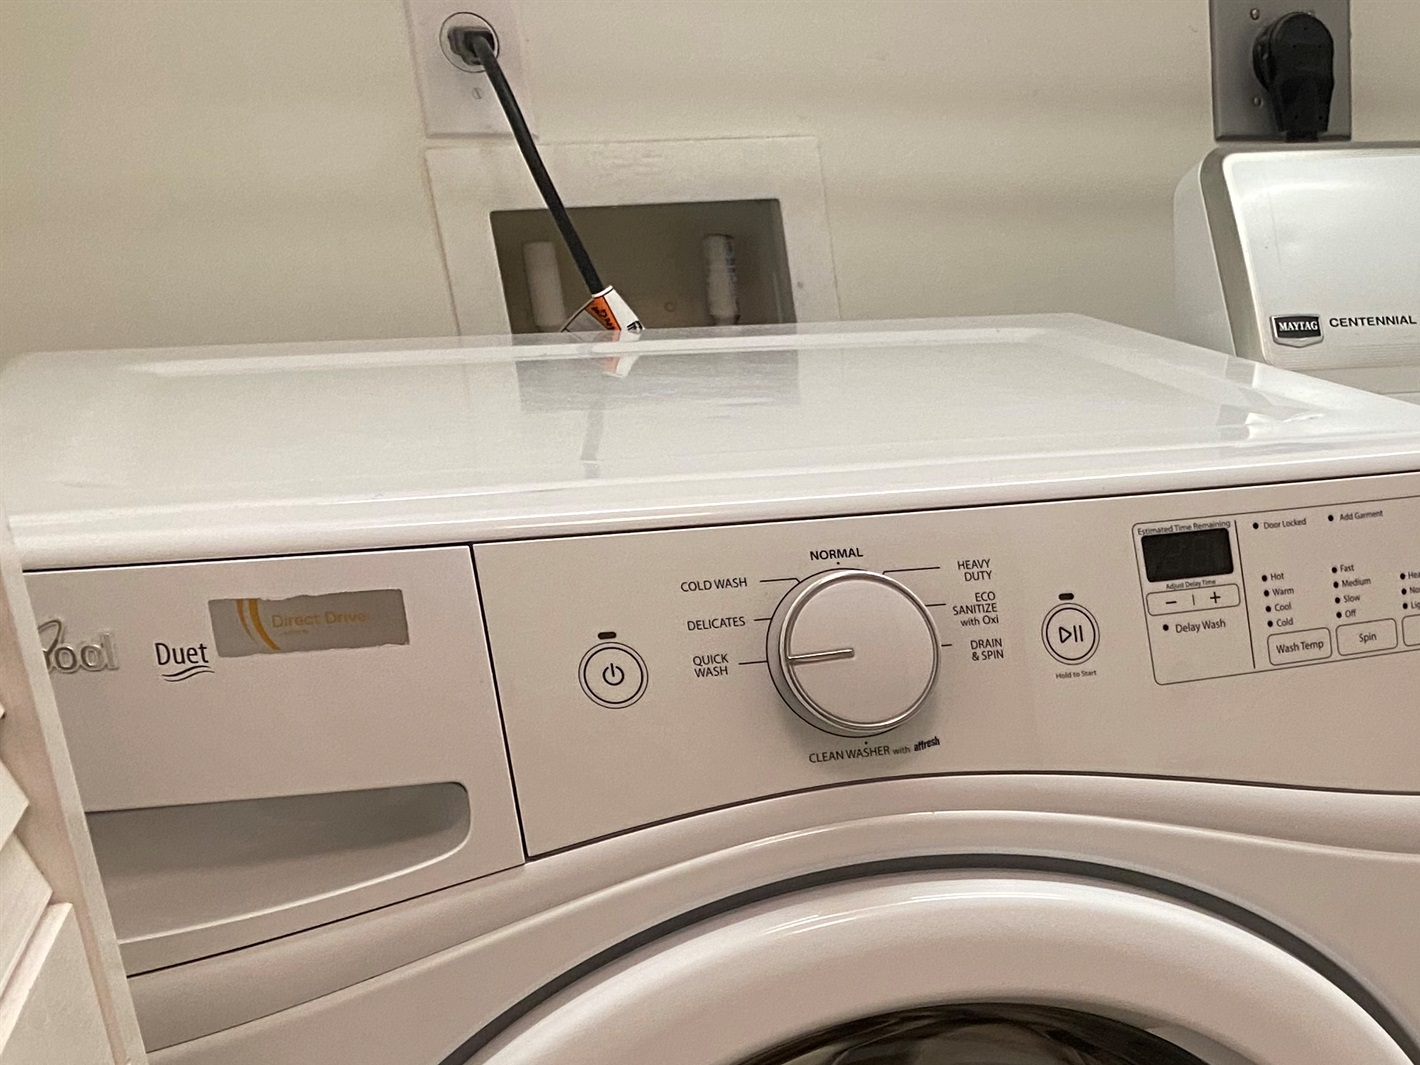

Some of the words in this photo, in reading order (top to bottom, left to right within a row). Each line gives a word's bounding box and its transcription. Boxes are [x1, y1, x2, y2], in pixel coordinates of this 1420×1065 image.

[1278, 321, 1319, 332] MAYTAG
[1329, 315, 1417, 328] CENTENNIAL
[1339, 513, 1353, 521] Add
[1354, 510, 1383, 520] Garment
[1137, 525, 1174, 536] Estimated
[1174, 523, 1192, 532] Time
[1192, 520, 1231, 530] Remaining
[1263, 521, 1281, 530] Door
[1281, 518, 1307, 528] Locked
[809, 547, 864, 561] NORMAL
[957, 558, 991, 570] HEAVY
[1340, 564, 1355, 573] Fast
[964, 570, 992, 582] DUTY
[1270, 572, 1284, 581] Hot
[680, 580, 712, 593] COLD
[713, 577, 748, 590] WASH
[1165, 582, 1184, 590] Adjust
[1184, 580, 1201, 588] Delay
[1341, 578, 1372, 588] Medium
[975, 591, 996, 602] ECO
[1272, 587, 1295, 596] Warm
[1343, 594, 1361, 603] Slow
[952, 603, 998, 616] SANITIZE
[1274, 602, 1292, 612] Cool
[271, 613, 320, 628] Direct
[324, 611, 368, 624] Drive
[1345, 609, 1356, 618] Off
[687, 616, 746, 631] DELICATES
[960, 618, 980, 627] with
[982, 615, 999, 625] Oxi
[1175, 621, 1201, 633] Delay
[1201, 619, 1226, 630] Wash
[1276, 617, 1294, 627] Cold
[1358, 632, 1377, 643] Spin
[970, 638, 1003, 650] DRAIN
[1275, 643, 1299, 654] Wash
[1300, 640, 1324, 651] Temp
[154, 642, 209, 666] Duet
[971, 652, 980, 661] &
[981, 650, 1004, 661] SPIN
[692, 653, 729, 668] QUICK
[694, 665, 729, 678] WASH
[1055, 670, 1072, 679] Hold
[808, 750, 845, 764] CLEAN
[846, 745, 891, 760] WASHER
[892, 745, 911, 756] with
[913, 736, 940, 752] affresh
